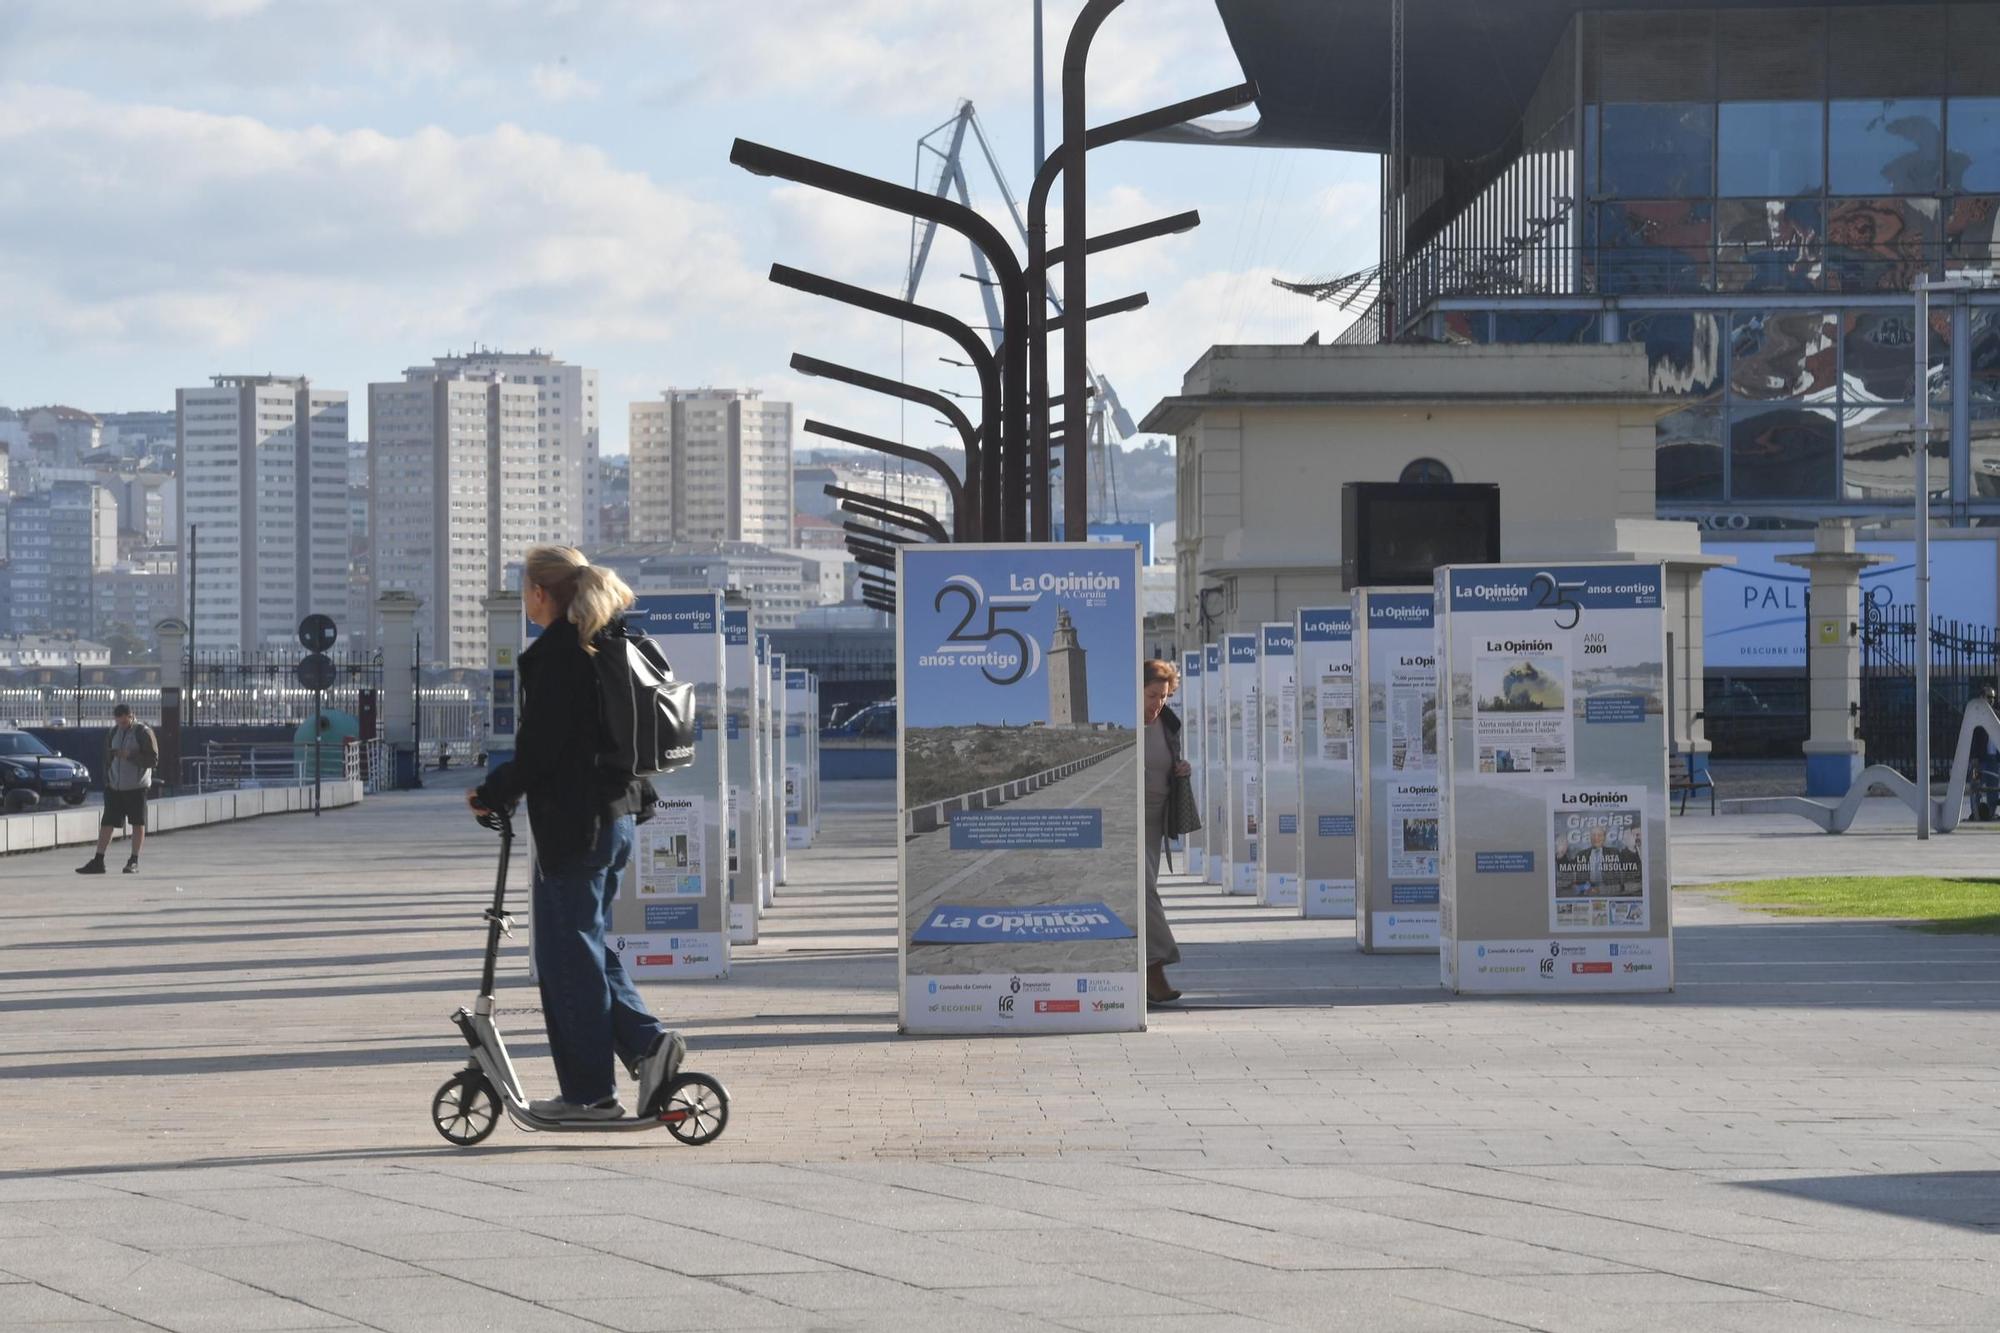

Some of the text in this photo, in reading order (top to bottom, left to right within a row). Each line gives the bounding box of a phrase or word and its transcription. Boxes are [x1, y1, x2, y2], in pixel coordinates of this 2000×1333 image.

[1010, 571, 1120, 595] La Opinión
[1073, 590, 1107, 599] Coruña
[1455, 585, 1473, 598] La
[1475, 584, 1528, 601] Opinión
[1587, 586, 1612, 595] anos
[1615, 583, 1655, 596] contigo
[650, 610, 711, 622] anos contigo
[1370, 605, 1430, 620] La Opinión
[934, 574, 1041, 686] 25
[1304, 622, 1317, 632] La
[1268, 637, 1280, 647] La
[1487, 639, 1553, 656] La Opinión
[1232, 647, 1243, 656] La
[1583, 644, 1608, 655] 2001
[1740, 647, 1788, 655] DESCUBRE
[918, 652, 1018, 669] anos contigo
[1401, 656, 1413, 666] La
[1329, 663, 1340, 673] La
[1398, 786, 1409, 794] La
[1561, 791, 1628, 806] La Opinión
[658, 799, 692, 810] Opinión
[1567, 812, 1633, 829] Gracias
[931, 912, 1109, 932] La Opinión
[1032, 925, 1091, 935] Coruña
